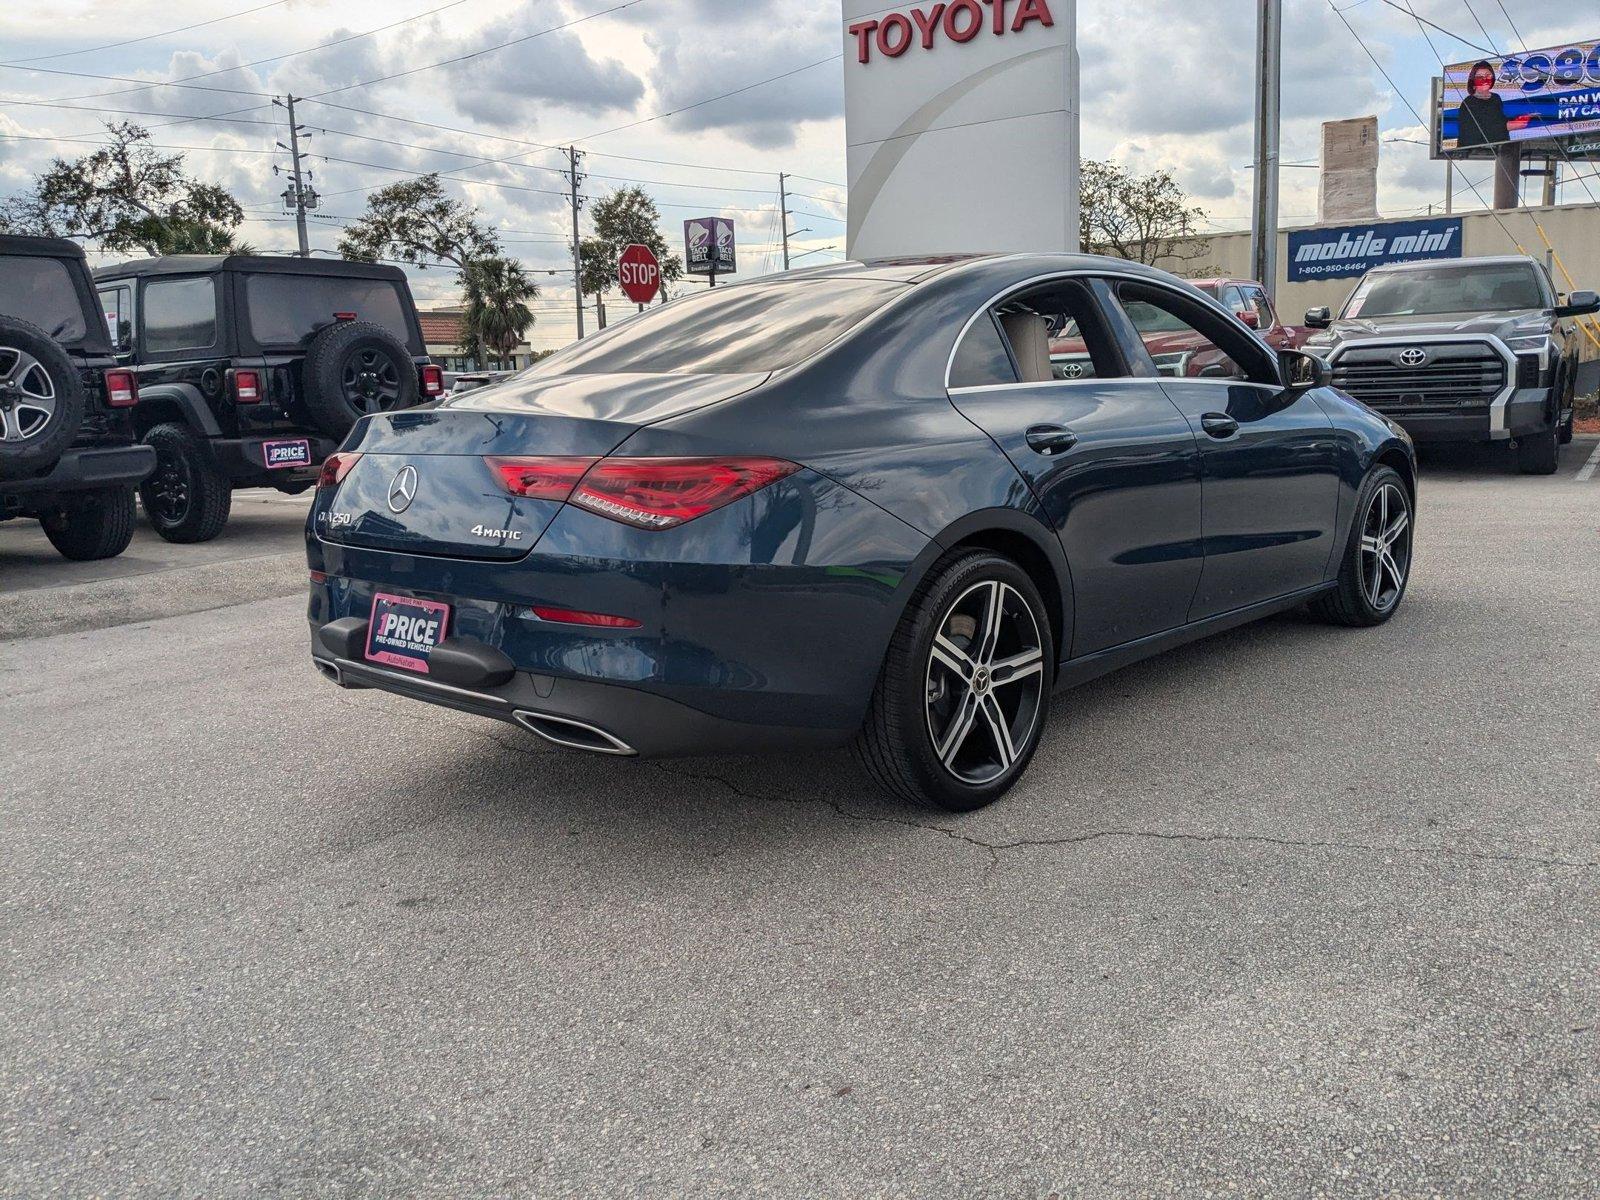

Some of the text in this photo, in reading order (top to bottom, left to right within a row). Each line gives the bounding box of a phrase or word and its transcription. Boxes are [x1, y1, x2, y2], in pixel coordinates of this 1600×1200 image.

[848, 0, 1054, 64] TOYOTA
[1558, 94, 1588, 105] DAN
[1558, 107, 1578, 119] MY
[691, 246, 708, 255] TACO
[719, 246, 733, 255] TACO
[1295, 228, 1454, 262] mobile mini
[692, 254, 709, 262] BELL
[720, 253, 733, 261] BELL
[621, 262, 657, 285] STOP
[1299, 262, 1367, 275] 1-800-950-6464
[471, 524, 522, 541] 4MATIC
[375, 635, 433, 653] PRE-OWNED VEHICLES
